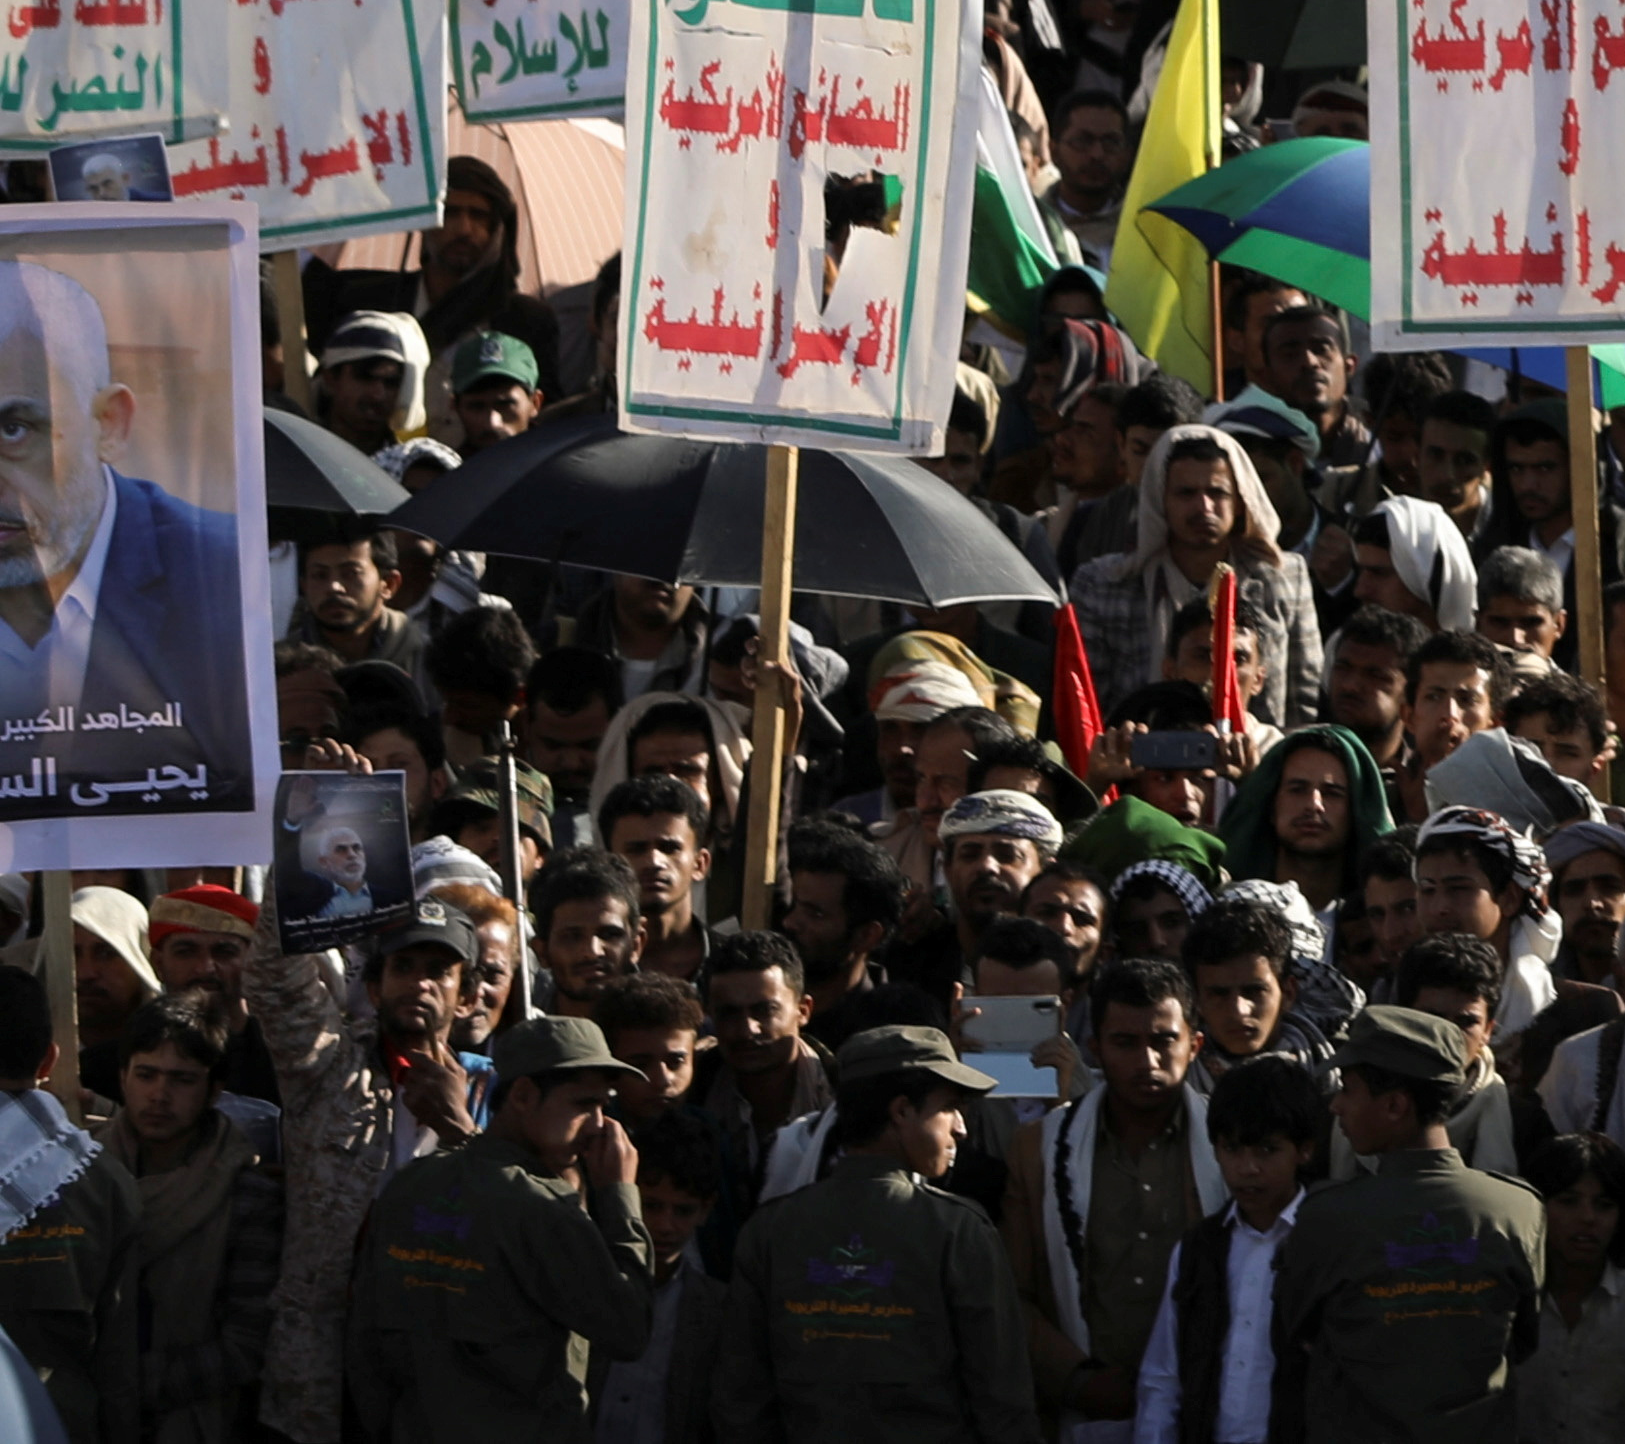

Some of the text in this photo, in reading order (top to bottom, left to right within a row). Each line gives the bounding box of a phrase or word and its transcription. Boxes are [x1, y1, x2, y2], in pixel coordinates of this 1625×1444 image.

[39, 46, 163, 131] النصر
[253, 38, 271, 95] و
[471, 9, 611, 94] للإسلام
[791, 71, 910, 164] البضائع
[1560, 98, 1582, 176] و
[765, 180, 779, 249] و
[644, 280, 897, 385] الإسرائيلية
[0, 701, 182, 741] المجاهد الكبير
[70, 763, 209, 806] يحيى
